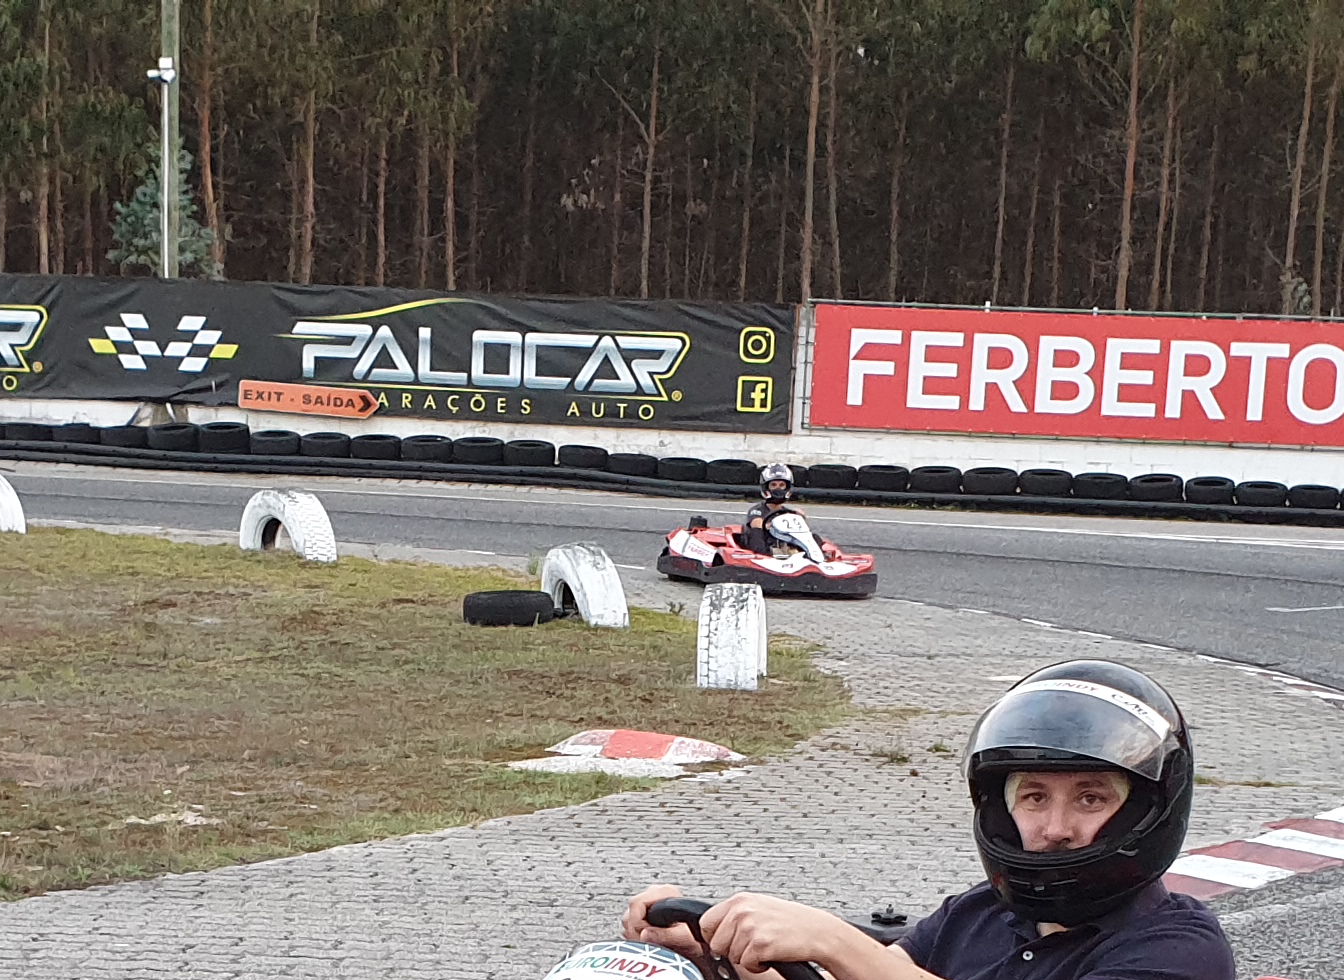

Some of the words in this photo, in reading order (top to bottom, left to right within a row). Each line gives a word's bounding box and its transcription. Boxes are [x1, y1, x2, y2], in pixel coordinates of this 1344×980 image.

[291, 321, 686, 395] PALOCAR
[242, 389, 284, 403] EXIT
[301, 392, 357, 411] SAÍDA
[566, 401, 655, 421] AUTO
